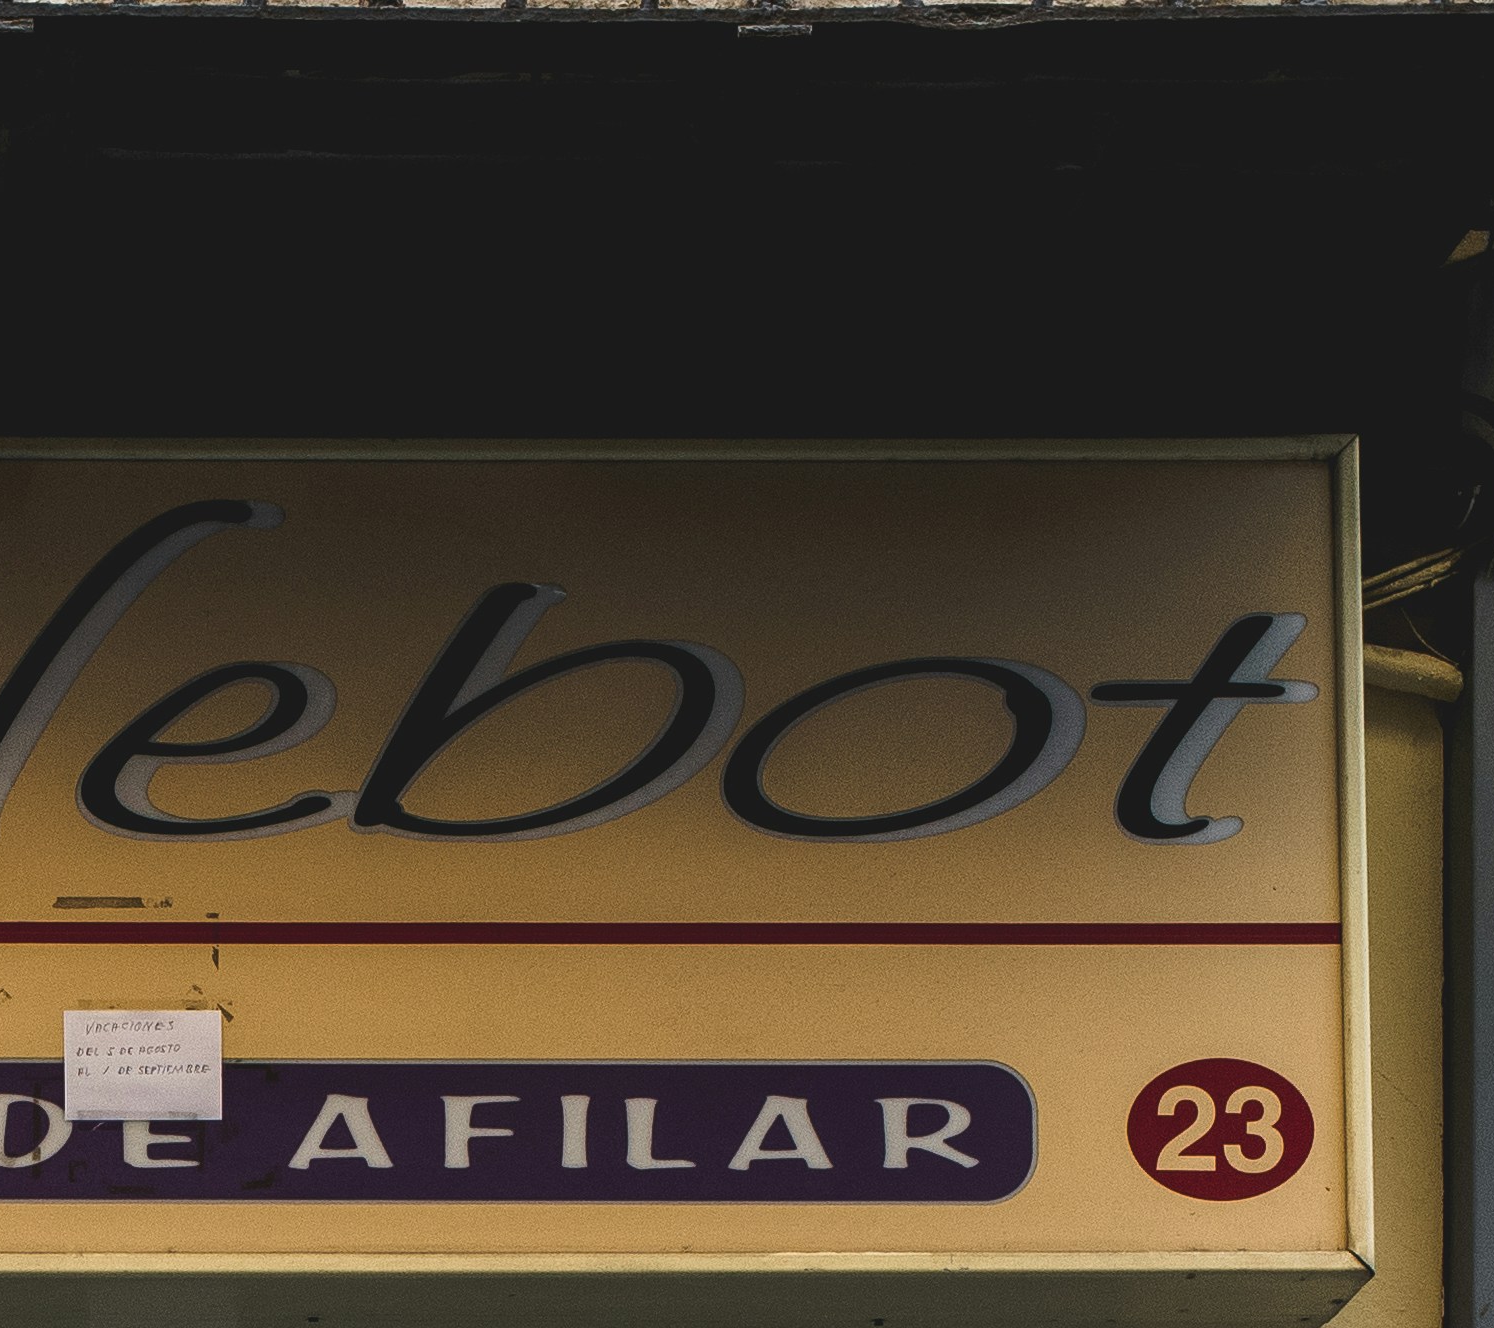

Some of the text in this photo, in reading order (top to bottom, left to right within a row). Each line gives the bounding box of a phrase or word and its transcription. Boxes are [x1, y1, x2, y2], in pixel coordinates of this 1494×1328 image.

[86, 1021, 174, 1035] VACACIONES
[76, 1047, 99, 1057] DEL
[119, 1046, 133, 1056] DE
[139, 1043, 181, 1056] AGOSTO
[78, 1068, 90, 1077] AL
[118, 1066, 133, 1075] DE
[138, 1064, 211, 1076] SEPTIEMBRE
[287, 1094, 980, 1170] AFILAR
[1154, 1085, 1286, 1175] 23
